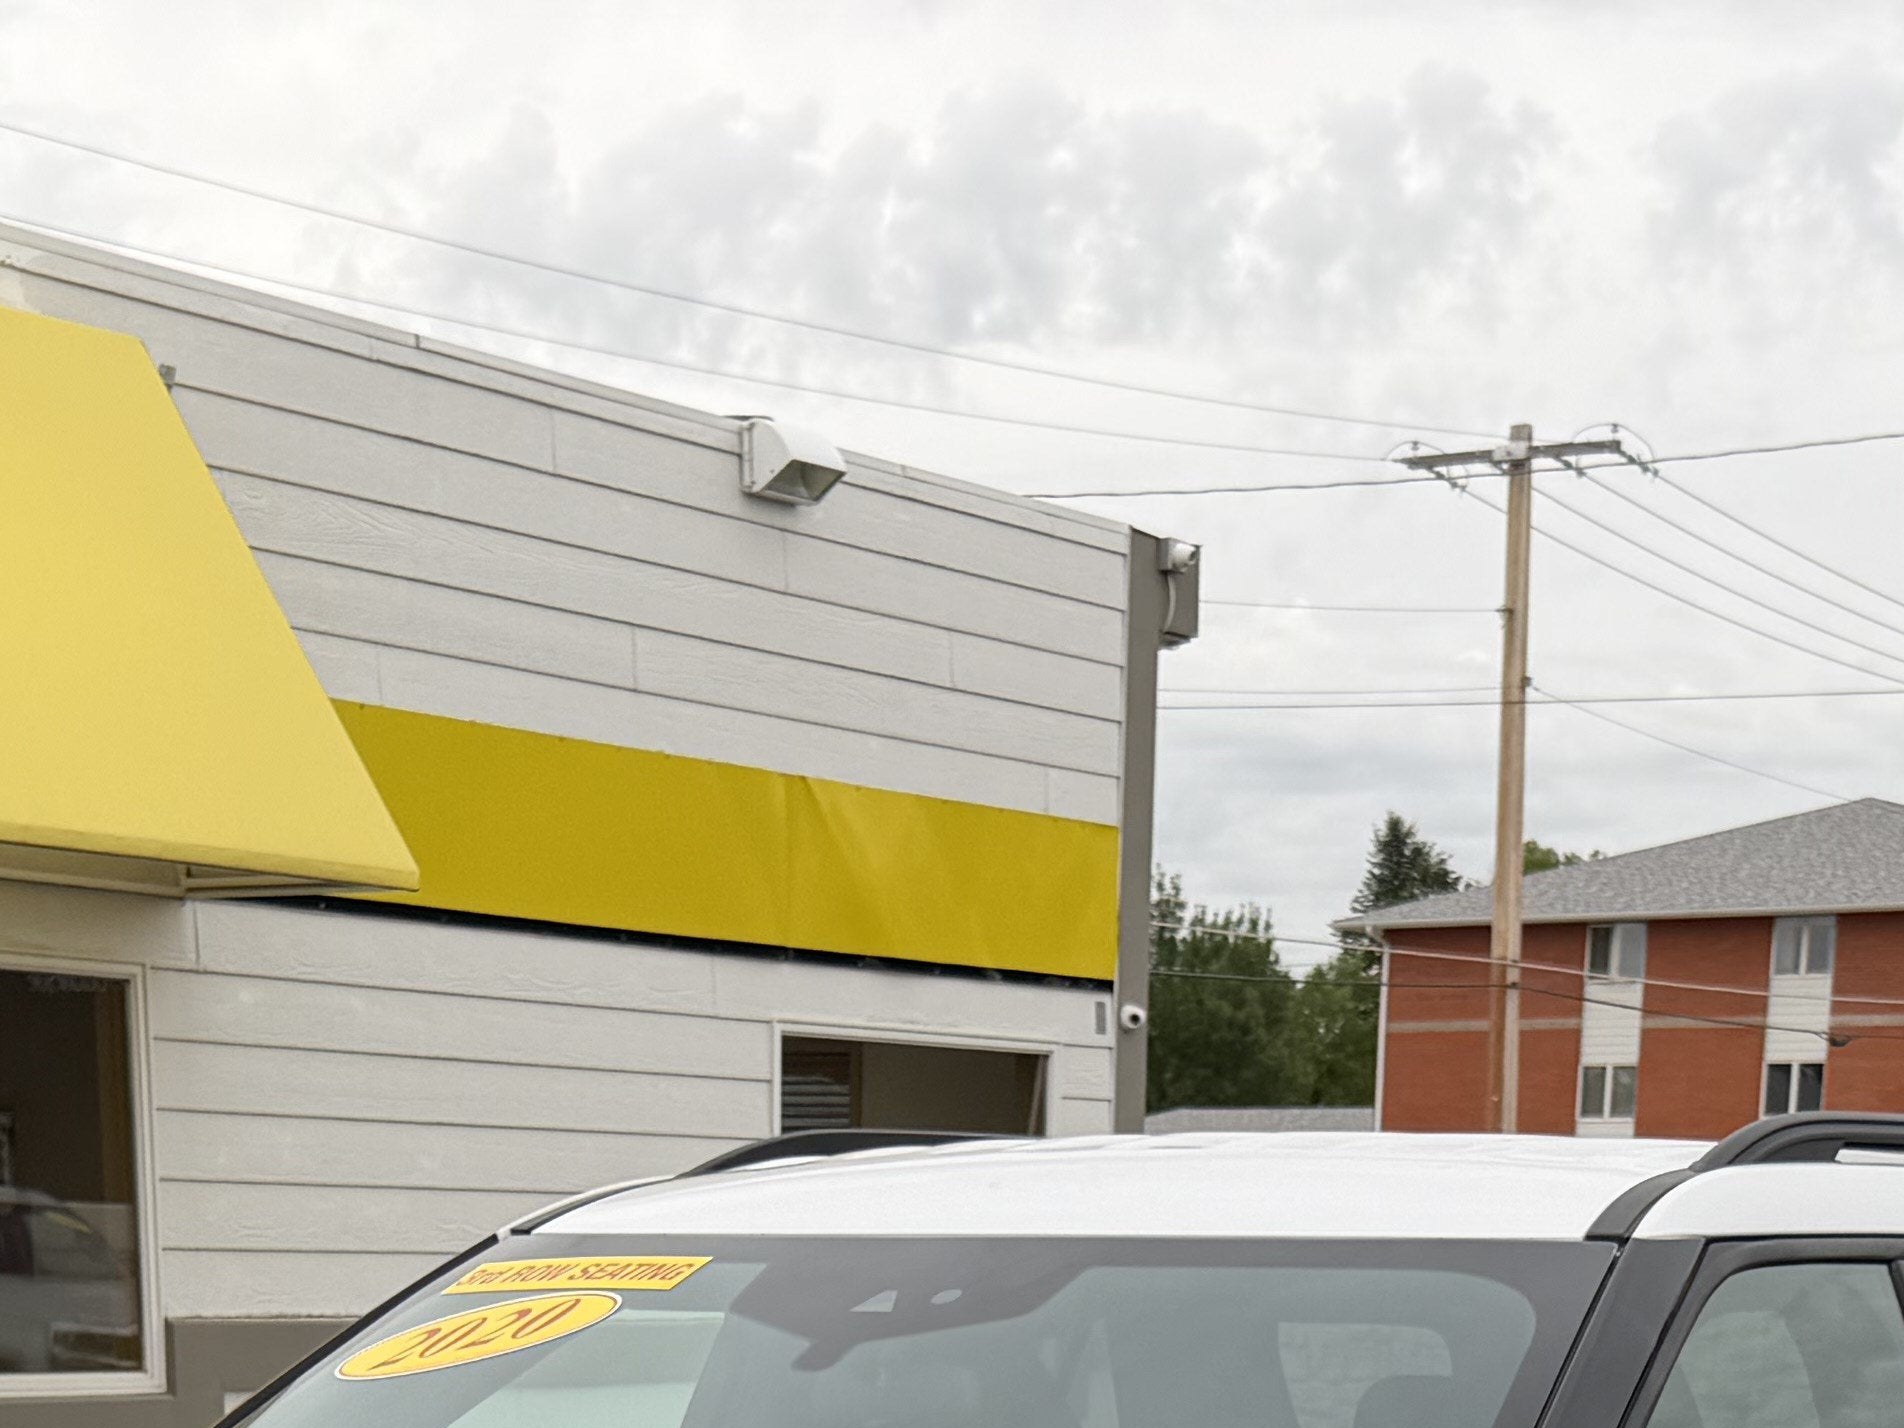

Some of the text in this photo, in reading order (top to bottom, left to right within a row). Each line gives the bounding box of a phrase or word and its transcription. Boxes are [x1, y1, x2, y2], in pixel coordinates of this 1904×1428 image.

[502, 1262, 574, 1284] ROW
[568, 1262, 696, 1281] SEATING
[365, 1297, 583, 1372] 2020
